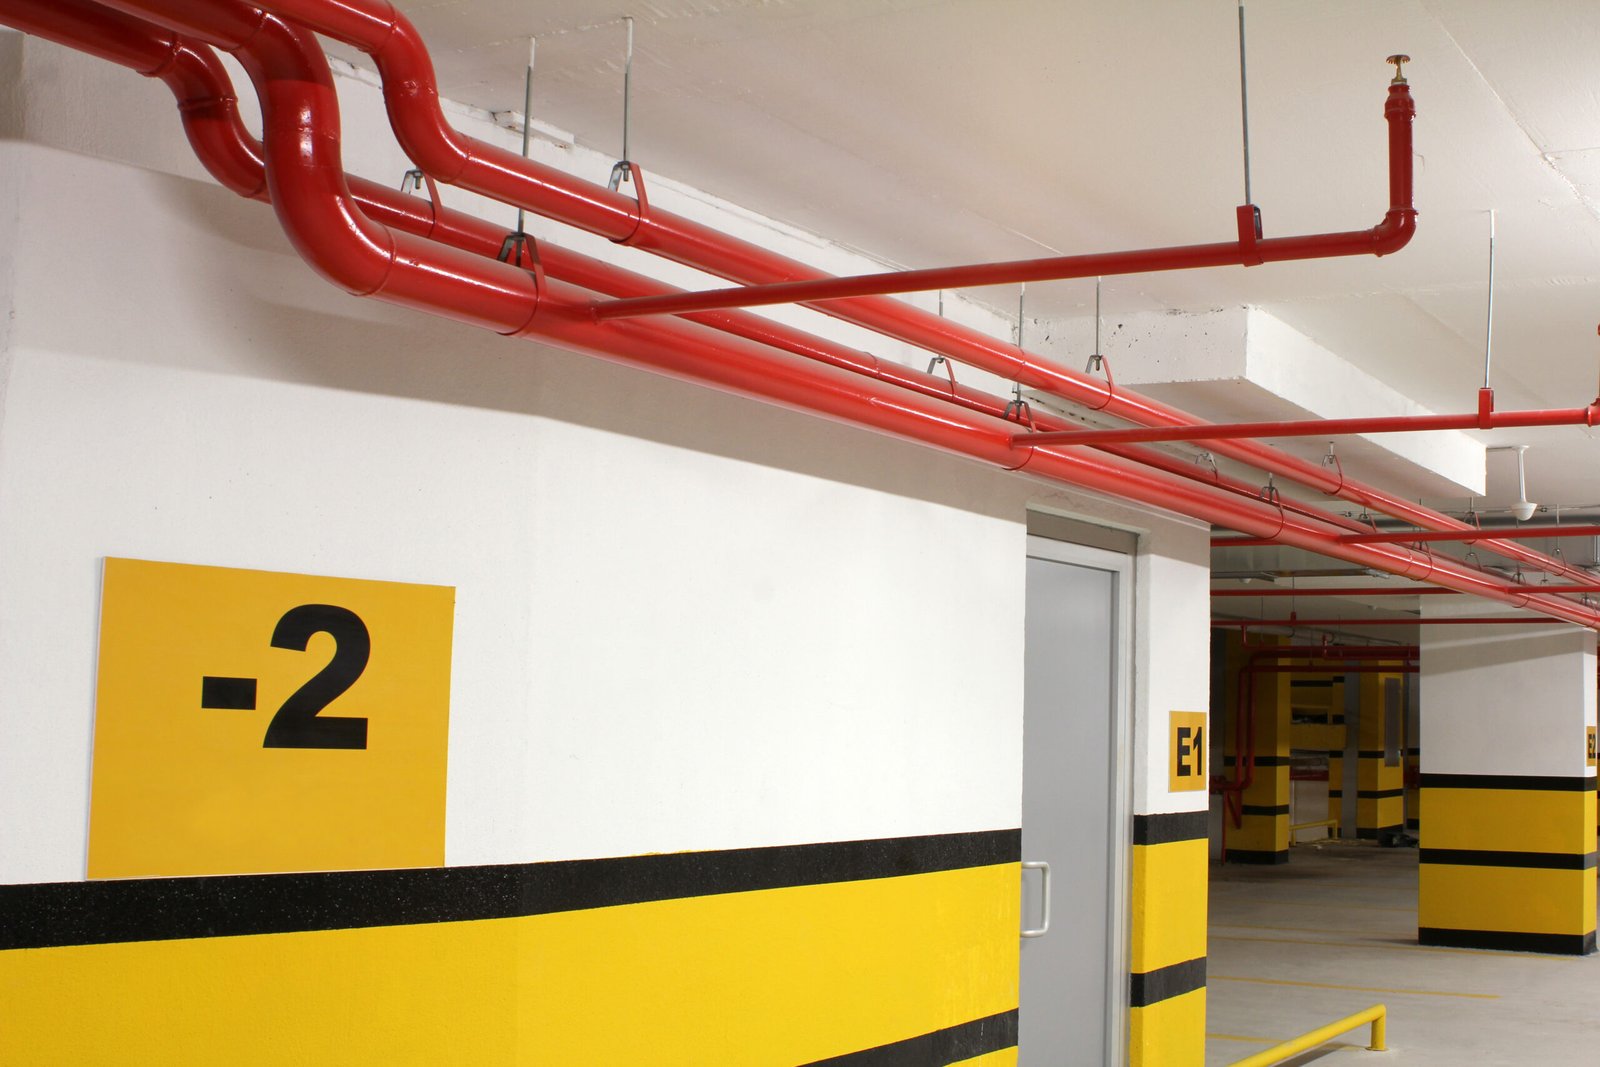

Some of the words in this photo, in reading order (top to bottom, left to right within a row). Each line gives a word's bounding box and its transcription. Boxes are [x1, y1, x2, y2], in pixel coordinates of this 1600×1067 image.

[201, 604, 370, 750] -2
[1177, 727, 1202, 776] E1
[1588, 734, 1596, 759] E2
